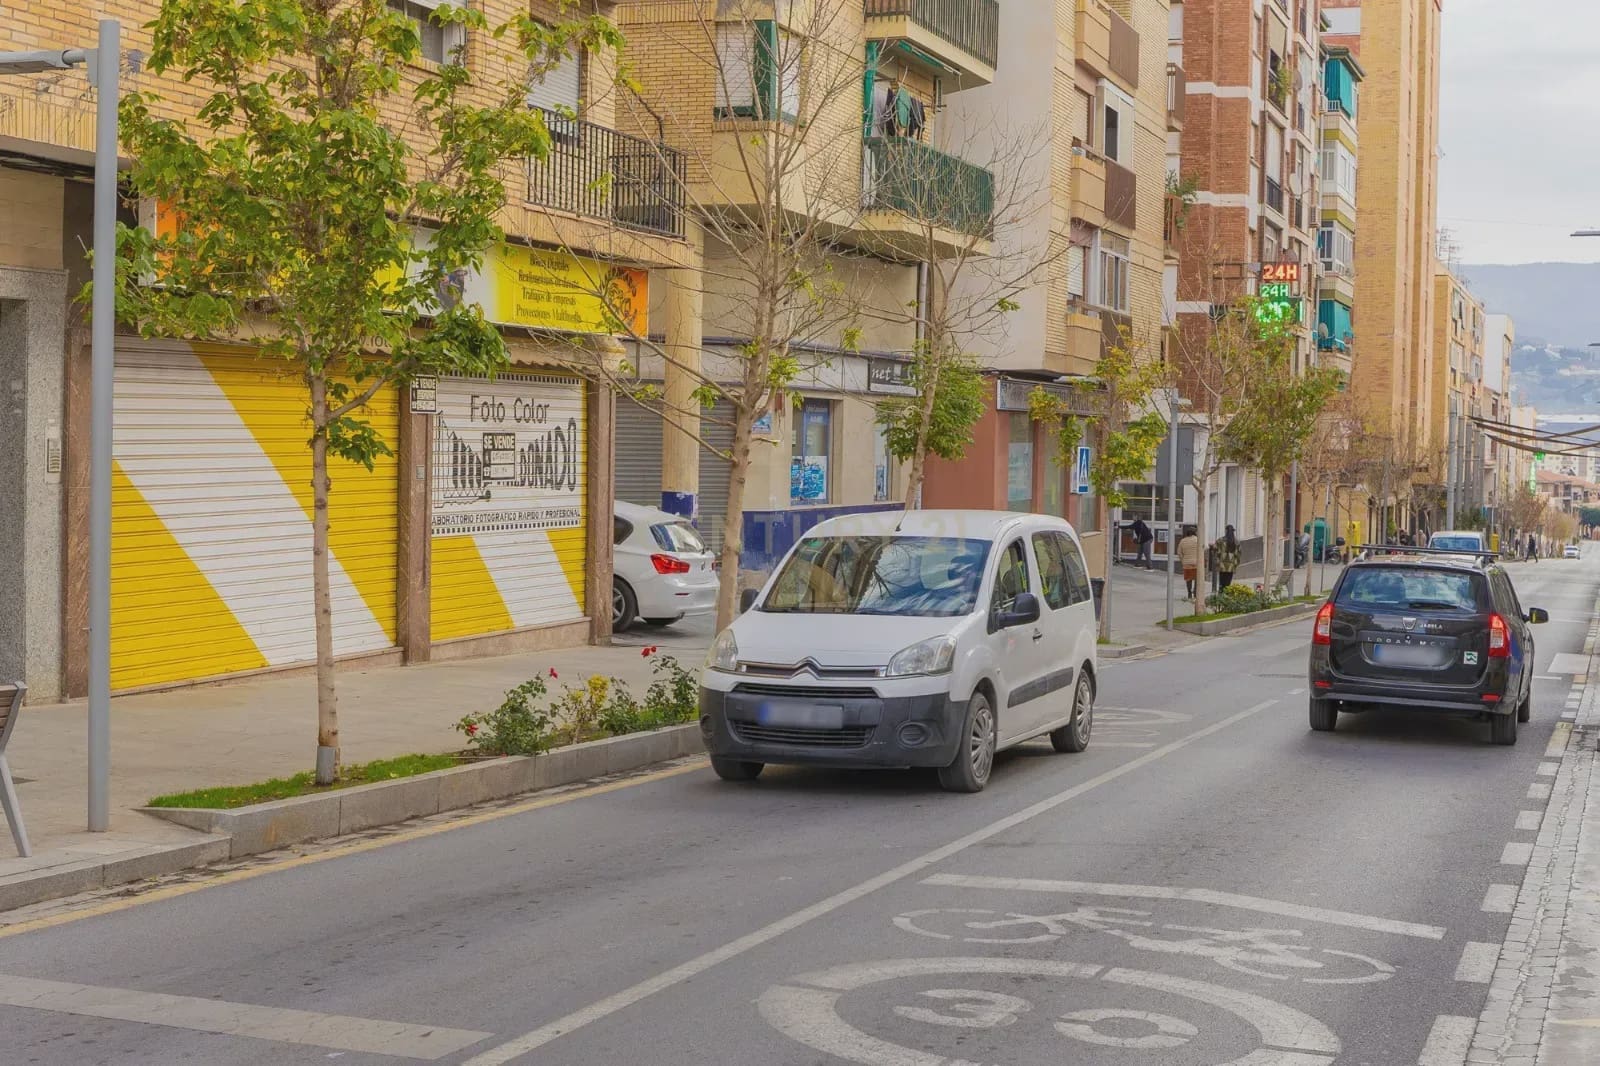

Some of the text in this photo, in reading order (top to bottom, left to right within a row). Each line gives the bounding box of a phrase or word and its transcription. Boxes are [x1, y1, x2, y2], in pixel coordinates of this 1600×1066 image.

[1262, 264, 1297, 280] 24H
[1261, 284, 1289, 297] 24H
[470, 395, 550, 425] Foto Color
[484, 435, 515, 449] SE VENDE
[432, 514, 474, 526] ABORATORIO
[1367, 636, 1412, 645] LOGAN
